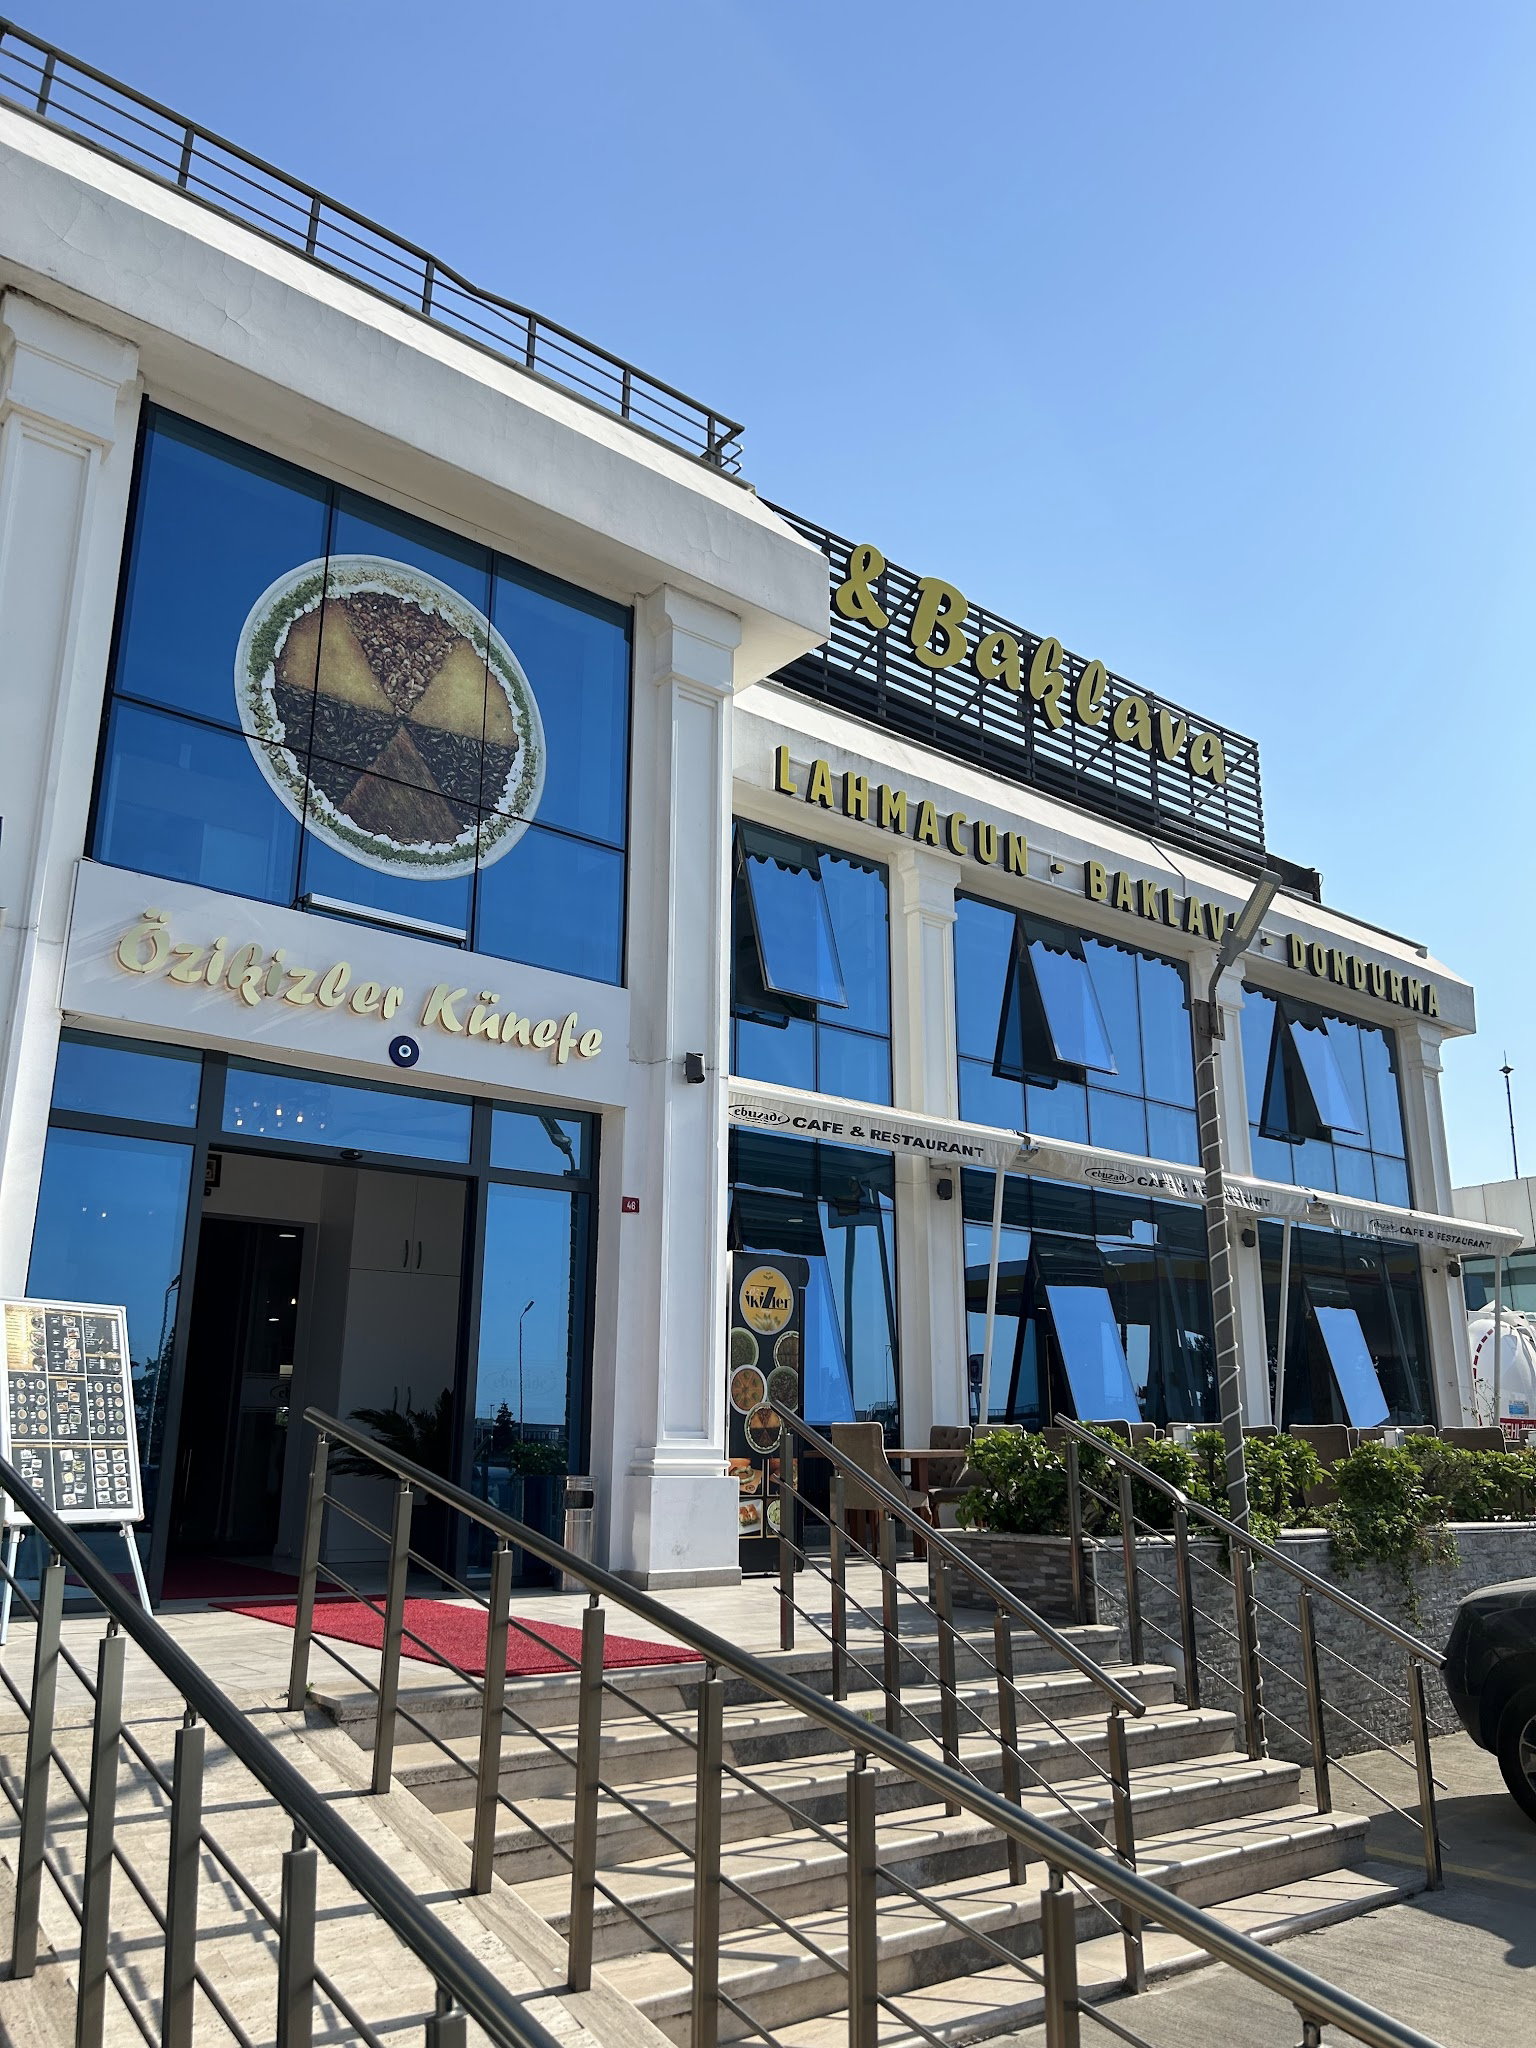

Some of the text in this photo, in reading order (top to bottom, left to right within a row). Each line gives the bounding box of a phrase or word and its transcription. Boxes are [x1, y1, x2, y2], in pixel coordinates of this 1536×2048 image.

[836, 544, 1226, 785] & Baklava
[775, 744, 1029, 877] LAHMACUN
[1084, 860, 1240, 942] BAKLAV
[1286, 932, 1441, 1018] DONDURMA
[421, 983, 603, 1065] Künefe
[792, 1116, 844, 1135] CAFE
[850, 1126, 865, 1138] &
[870, 1128, 984, 1158] RESTAURANT
[1400, 1226, 1425, 1238] CAFE
